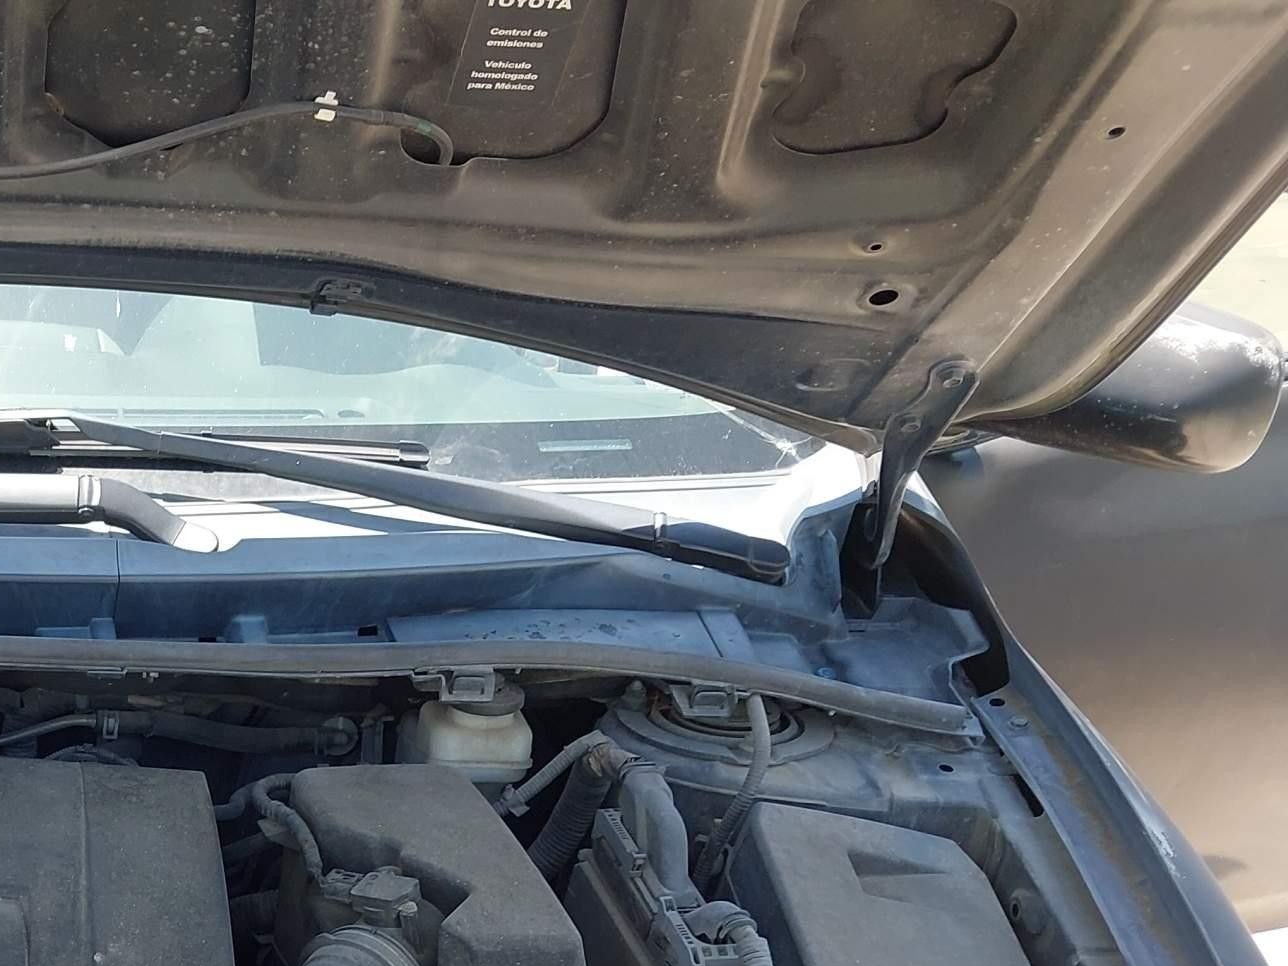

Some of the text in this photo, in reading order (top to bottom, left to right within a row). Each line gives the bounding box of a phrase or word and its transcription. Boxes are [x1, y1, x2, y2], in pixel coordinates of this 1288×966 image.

[487, 0, 572, 10] TOYOTA
[490, 27, 548, 37] Control de
[486, 40, 543, 48] emisiones
[471, 70, 538, 81] homologado
[467, 82, 493, 90] para
